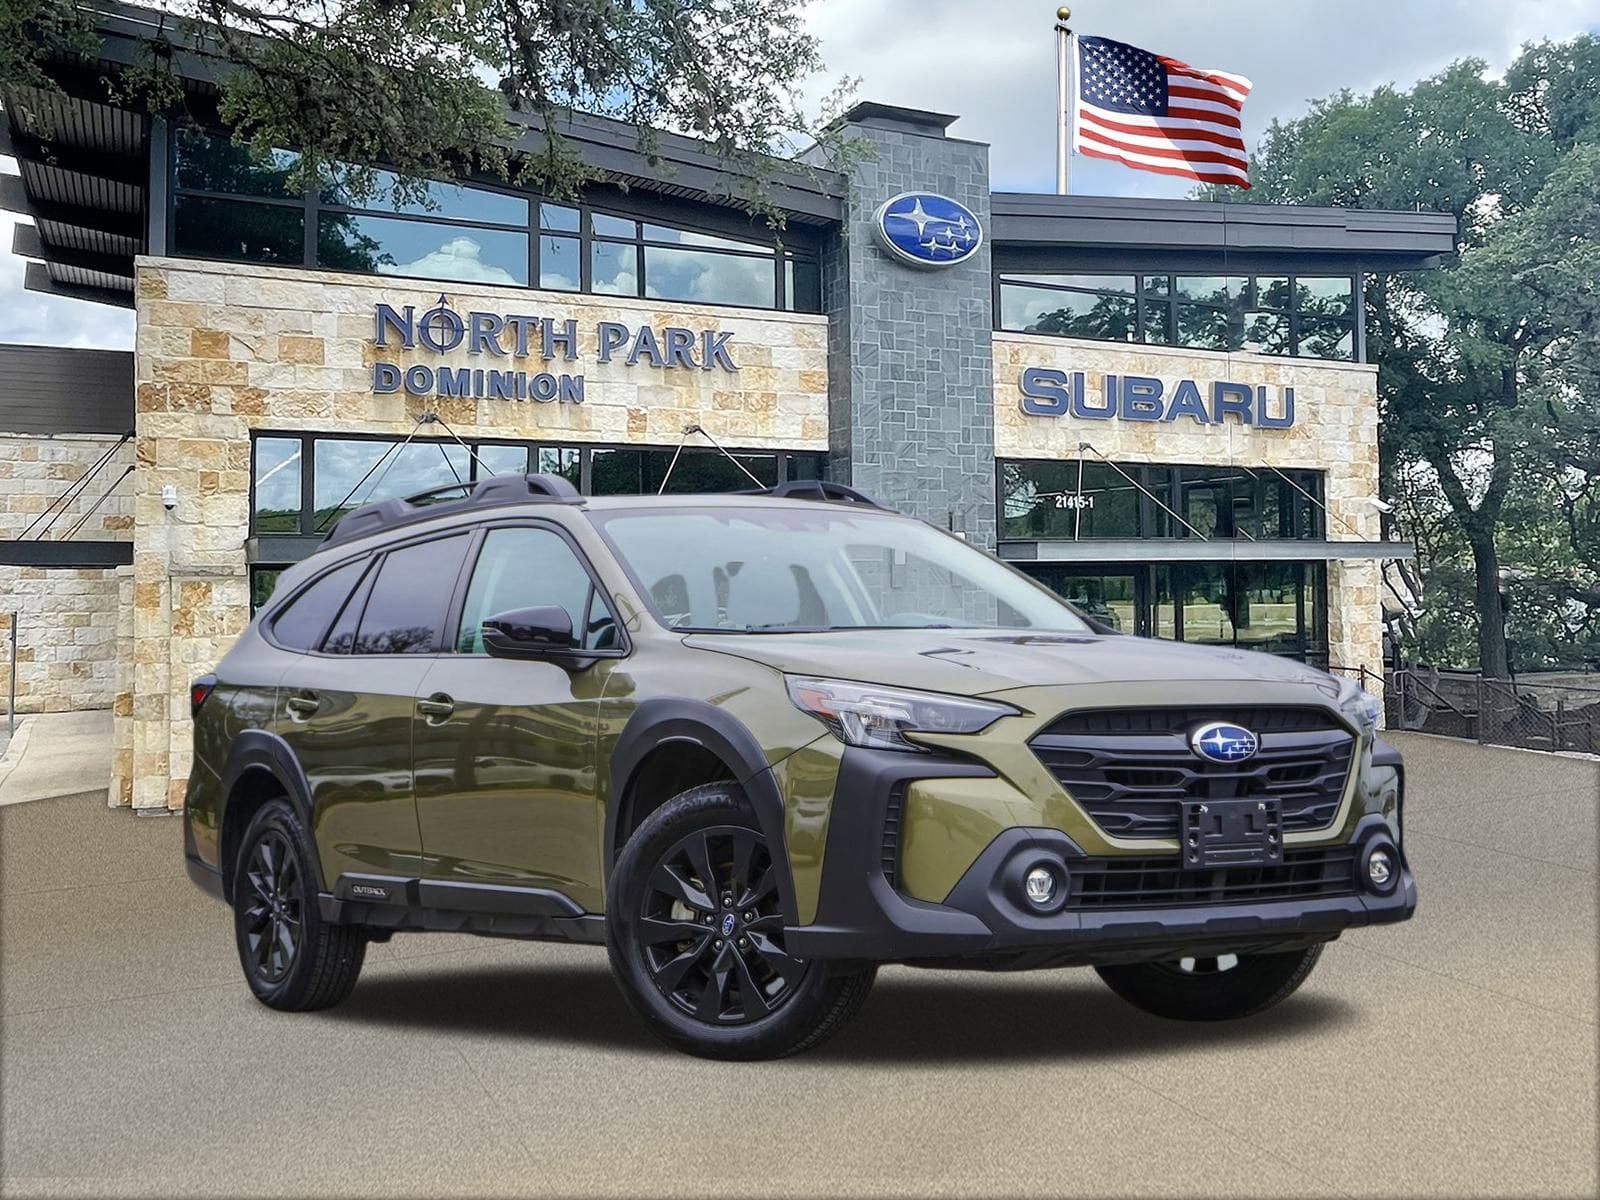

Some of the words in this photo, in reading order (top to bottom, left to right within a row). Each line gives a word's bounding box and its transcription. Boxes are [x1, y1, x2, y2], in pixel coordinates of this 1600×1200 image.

[374, 299, 579, 361] NORTH
[598, 321, 741, 372] PARK
[373, 362, 585, 404] DOMINION
[1019, 367, 1295, 430] SUBARU
[353, 885, 386, 896] OUTBACK
